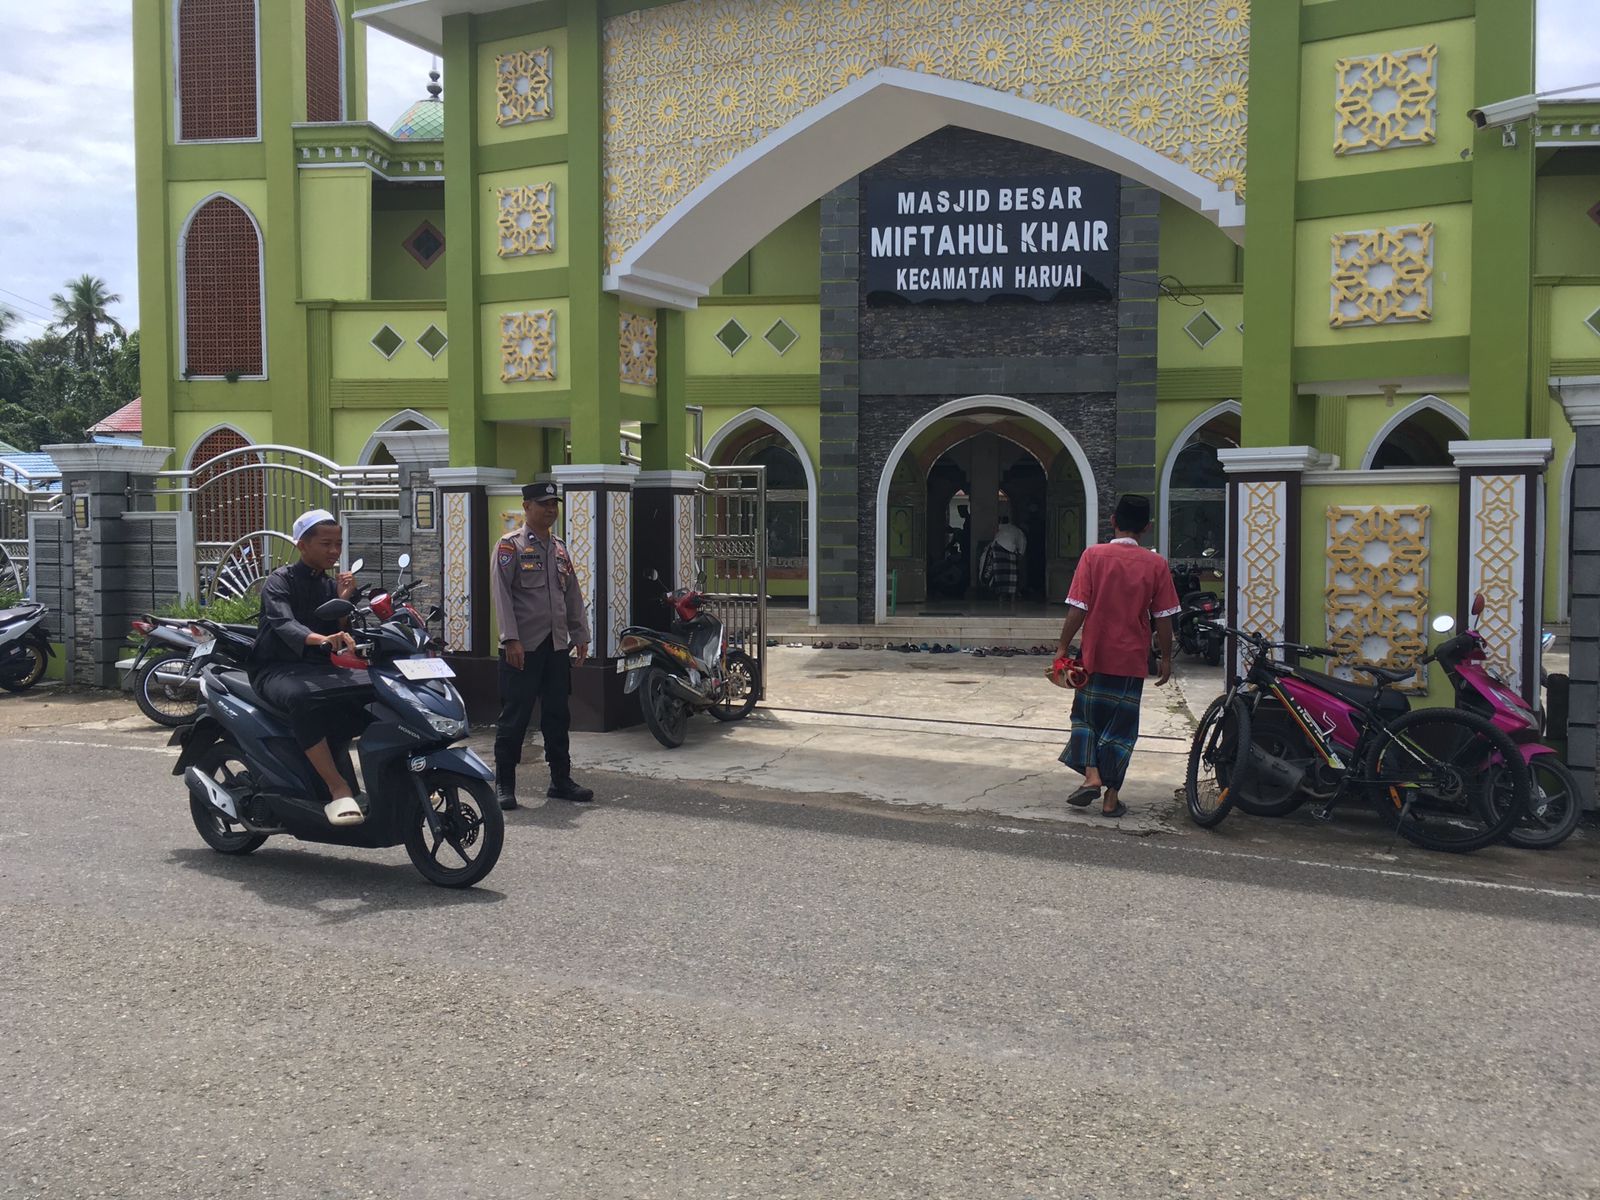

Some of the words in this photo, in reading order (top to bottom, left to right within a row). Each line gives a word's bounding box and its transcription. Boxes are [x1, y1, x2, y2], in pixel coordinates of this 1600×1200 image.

[897, 189, 990, 214] MASJID
[999, 186, 1082, 211] BESAR
[871, 223, 1008, 257] MIFTAHUL
[1021, 220, 1109, 253] KHAIR
[896, 266, 1003, 290] KECAMATAN
[1015, 265, 1081, 288] HARUAI
[397, 724, 421, 740] HONDA
